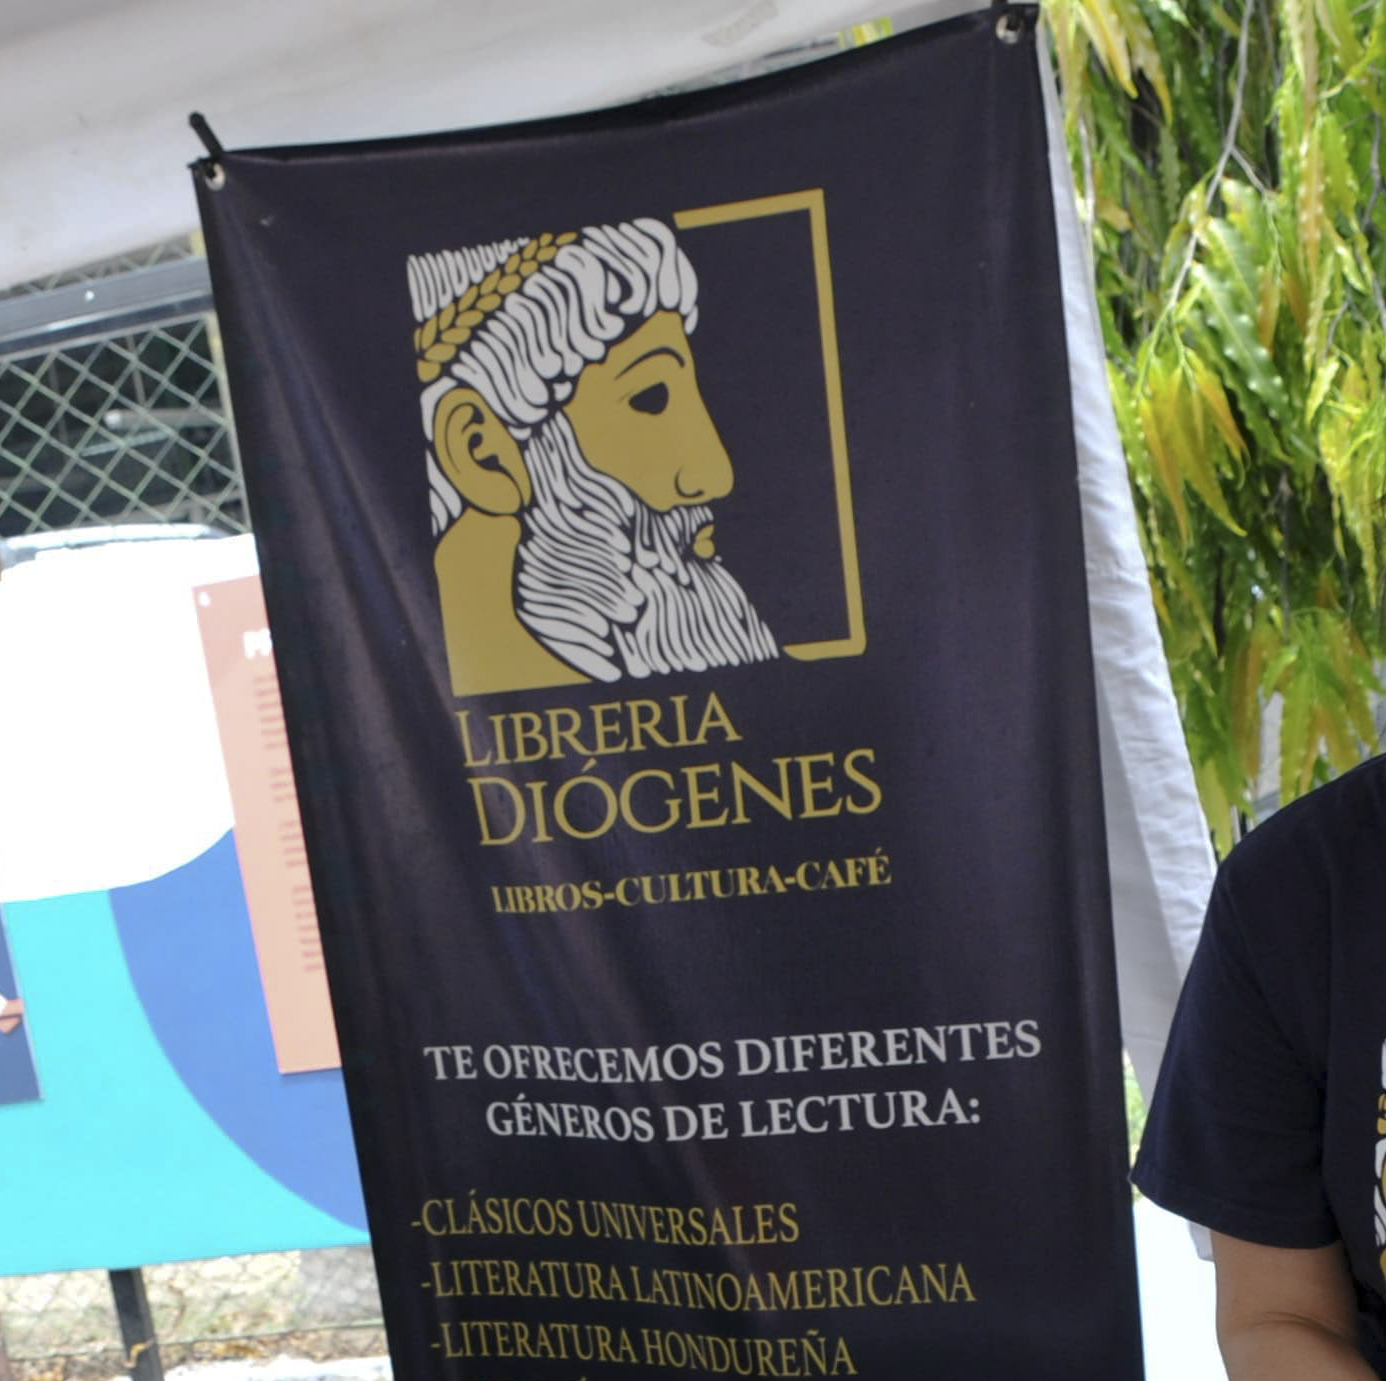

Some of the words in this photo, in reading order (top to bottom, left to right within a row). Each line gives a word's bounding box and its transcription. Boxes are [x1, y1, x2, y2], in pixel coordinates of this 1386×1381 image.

[454, 692, 741, 767] LIBRERIA
[467, 747, 883, 846] DIÓGENES
[491, 848, 891, 915] LIBROS-CULTURA-CAFÉ
[424, 1045, 477, 1081] TE
[484, 1041, 723, 1083] OFRECEMOS
[737, 1020, 1042, 1077] DIFERENTES
[486, 1093, 654, 1142] GÉNEROS
[666, 1103, 729, 1142] DE
[741, 1088, 980, 1139] LECTURA:
[411, 1191, 573, 1239] -CLÁSICOS
[581, 1200, 800, 1246] UNIVERSALES
[421, 1261, 626, 1299] -LITERATURA
[628, 1263, 976, 1312] LATINOAMERICANA
[431, 1321, 637, 1363] -LITERATURA
[645, 1332, 857, 1377] HONDUREÑA
